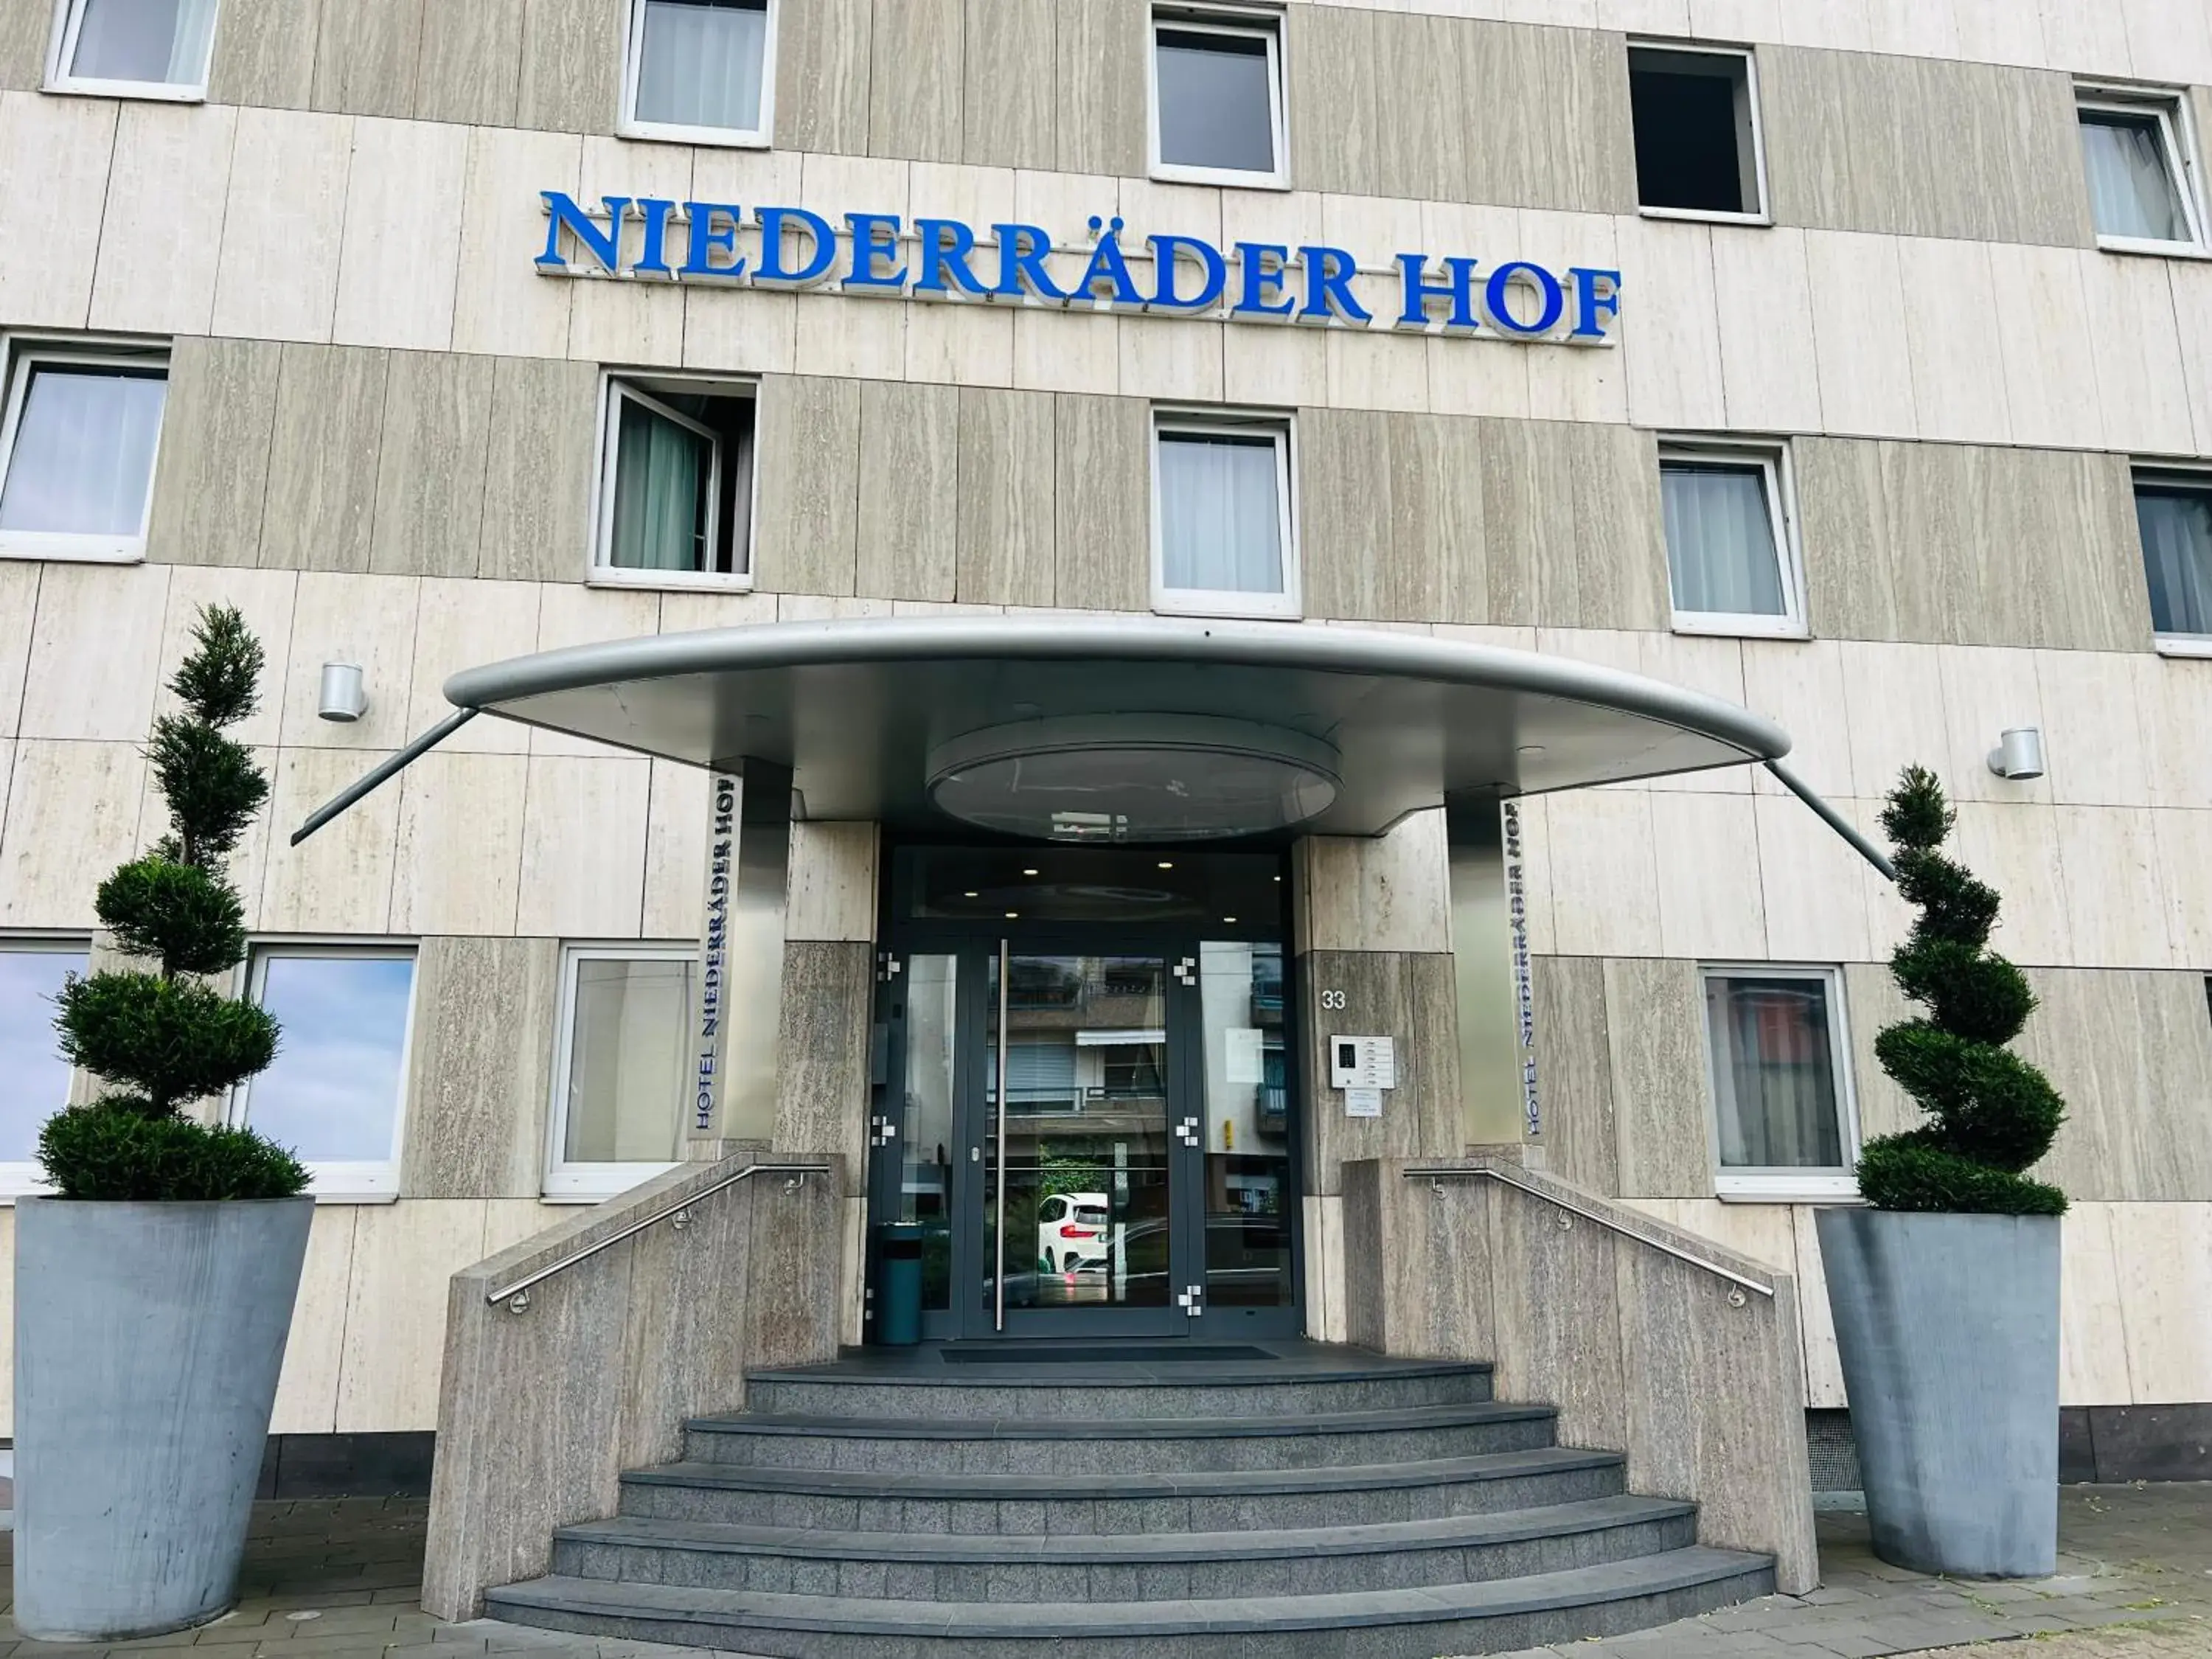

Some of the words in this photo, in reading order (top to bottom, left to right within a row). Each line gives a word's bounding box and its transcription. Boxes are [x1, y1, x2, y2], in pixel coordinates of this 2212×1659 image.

[537, 190, 1371, 327] NIEDERRÄDER
[1395, 252, 1622, 338] HOF
[714, 778, 734, 837] HOF
[702, 840, 730, 1037] NIEDERRÄDER
[1322, 990, 1345, 1009] 33
[696, 1044, 714, 1130] HOTEL
[1524, 1055, 1540, 1136] HOTEL
